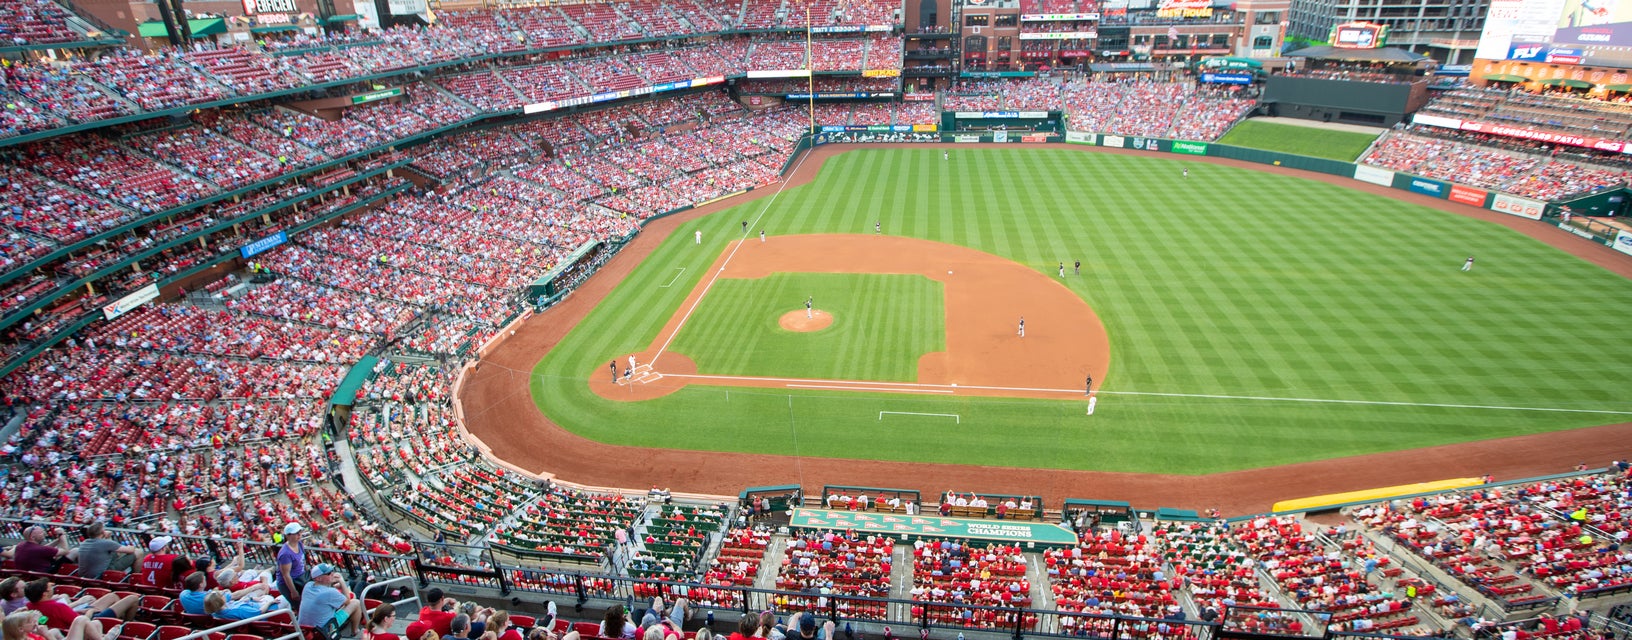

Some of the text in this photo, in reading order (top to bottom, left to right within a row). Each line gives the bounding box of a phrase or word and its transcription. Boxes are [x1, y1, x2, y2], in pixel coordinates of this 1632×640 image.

[243, 0, 297, 15] PERFICIENT
[1157, 8, 1213, 17] BREW HOUSE
[257, 14, 290, 24] PERCH
[1513, 47, 1542, 58] FLY
[1492, 126, 1552, 141] SCOREBOARD
[1553, 135, 1584, 145] PATIO
[254, 233, 281, 248] SITEMAN
[967, 528, 1032, 538] CHAMPIONS
[143, 561, 164, 569] MOLINA
[147, 570, 156, 585] 4
